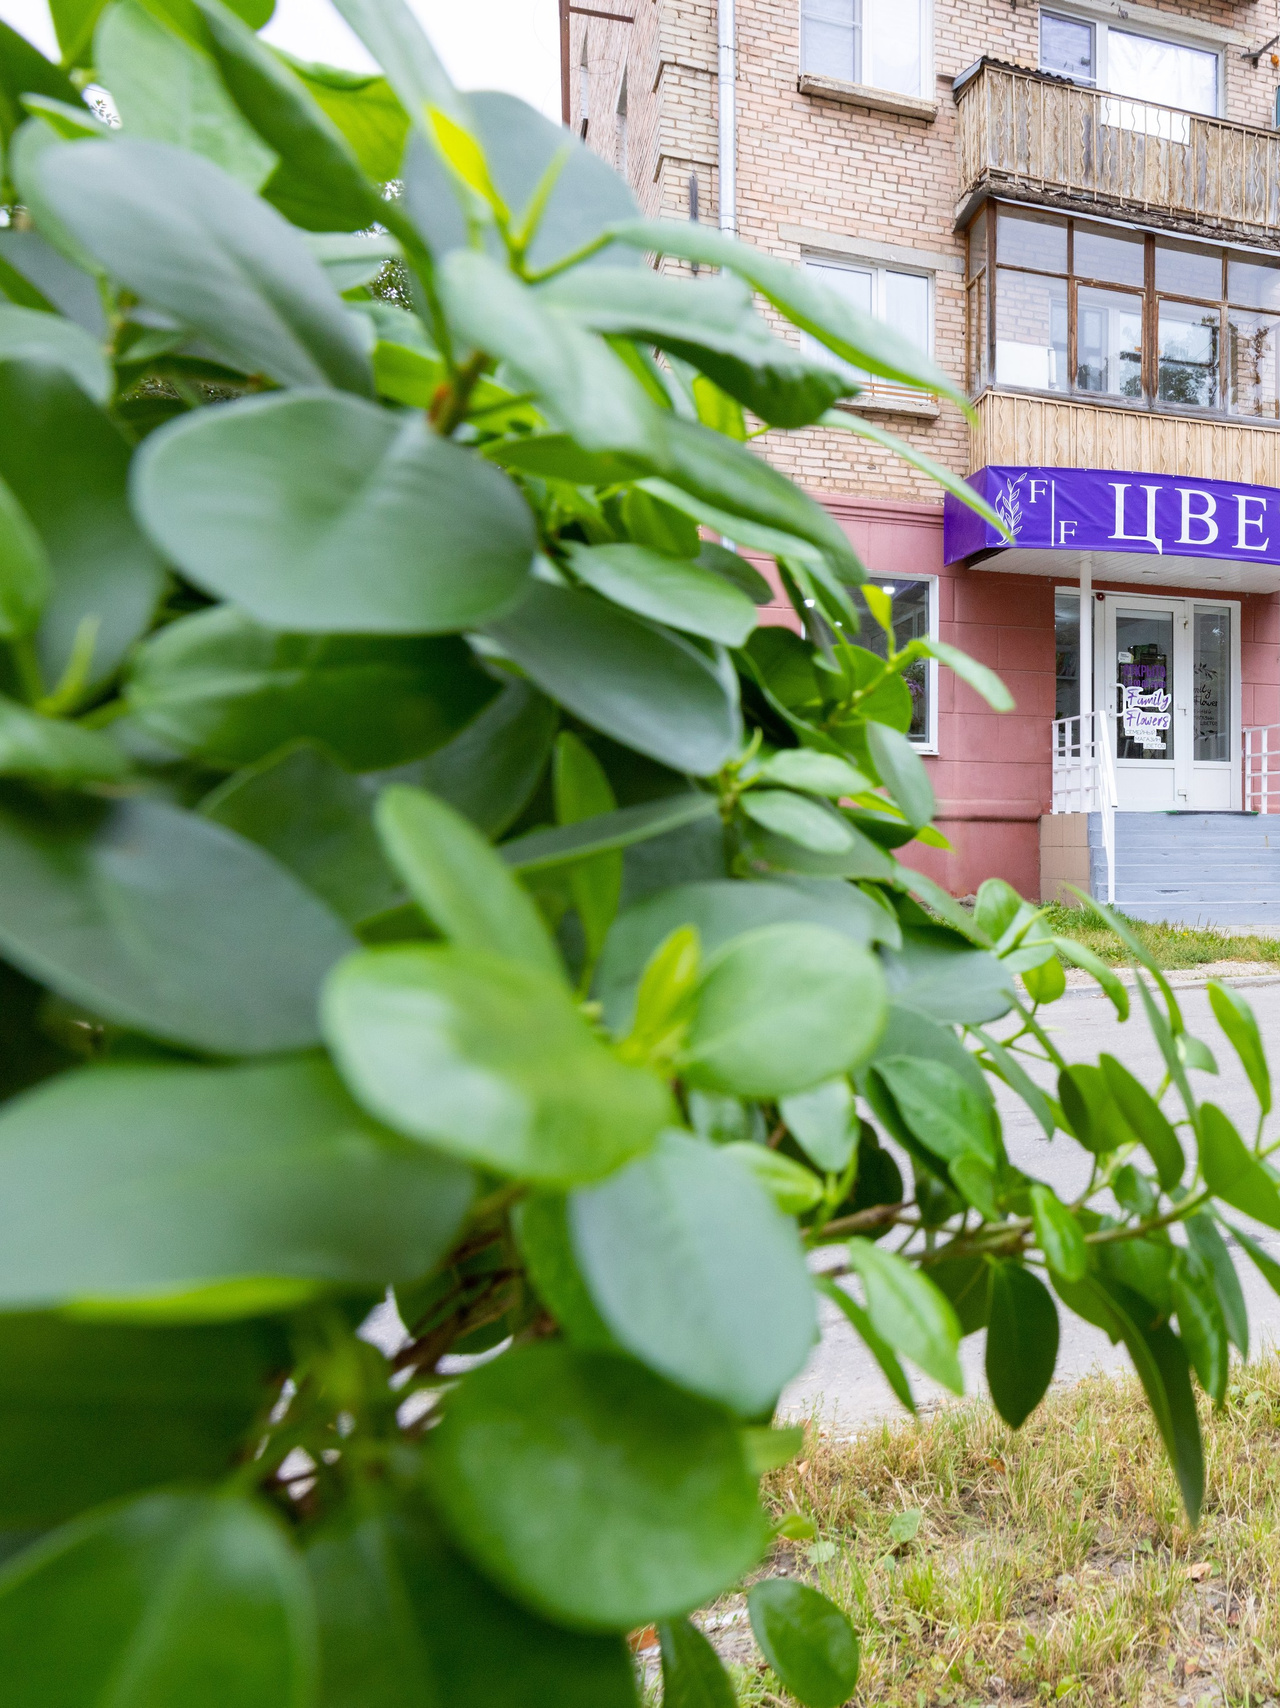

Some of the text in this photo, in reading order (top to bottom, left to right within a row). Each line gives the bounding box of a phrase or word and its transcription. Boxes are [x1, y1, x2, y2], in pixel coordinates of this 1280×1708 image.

[1029, 479, 1049, 503] F
[1058, 520, 1078, 544] F
[1127, 688, 1169, 711] Family
[1126, 709, 1169, 728] Flowers
